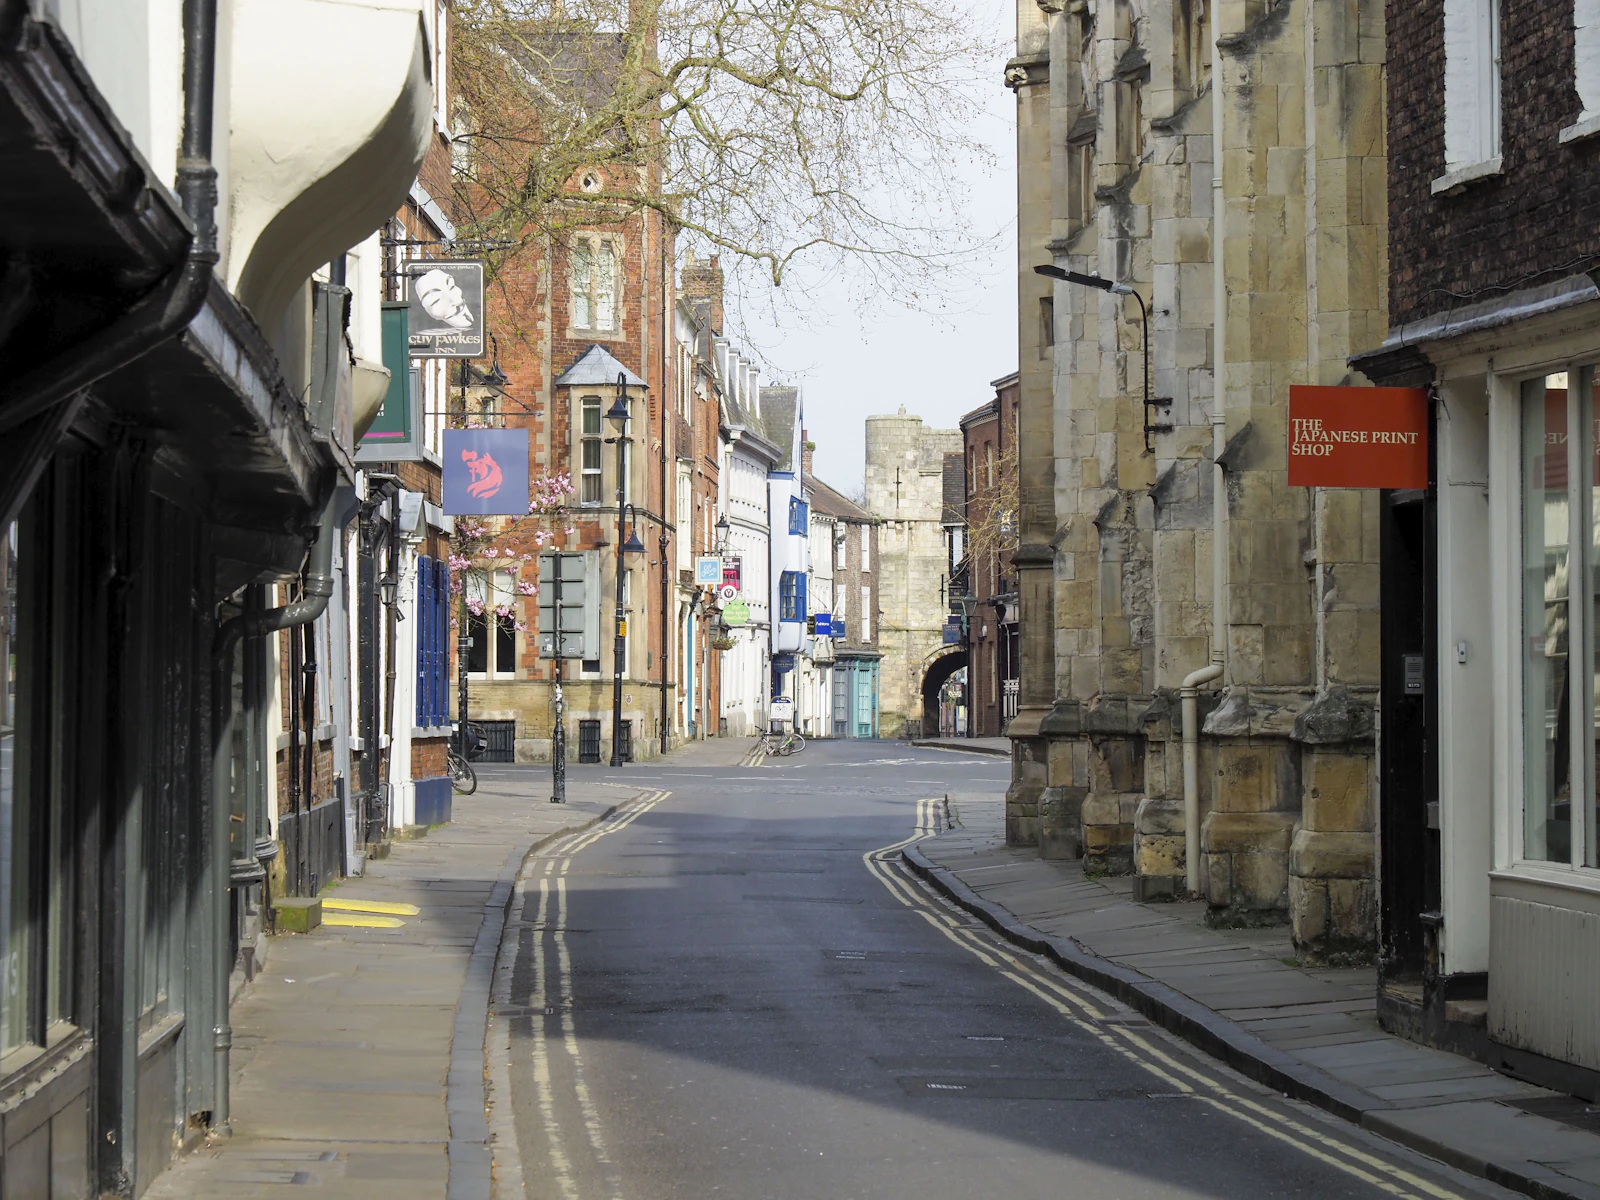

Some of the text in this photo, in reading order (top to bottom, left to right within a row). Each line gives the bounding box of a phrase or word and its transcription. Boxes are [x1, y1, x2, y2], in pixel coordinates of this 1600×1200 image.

[408, 333, 481, 347] GUY FAWKES
[1292, 418, 1323, 432] THE
[1293, 430, 1418, 445] JAPANESE PRINT
[1291, 443, 1334, 456] SHOP
